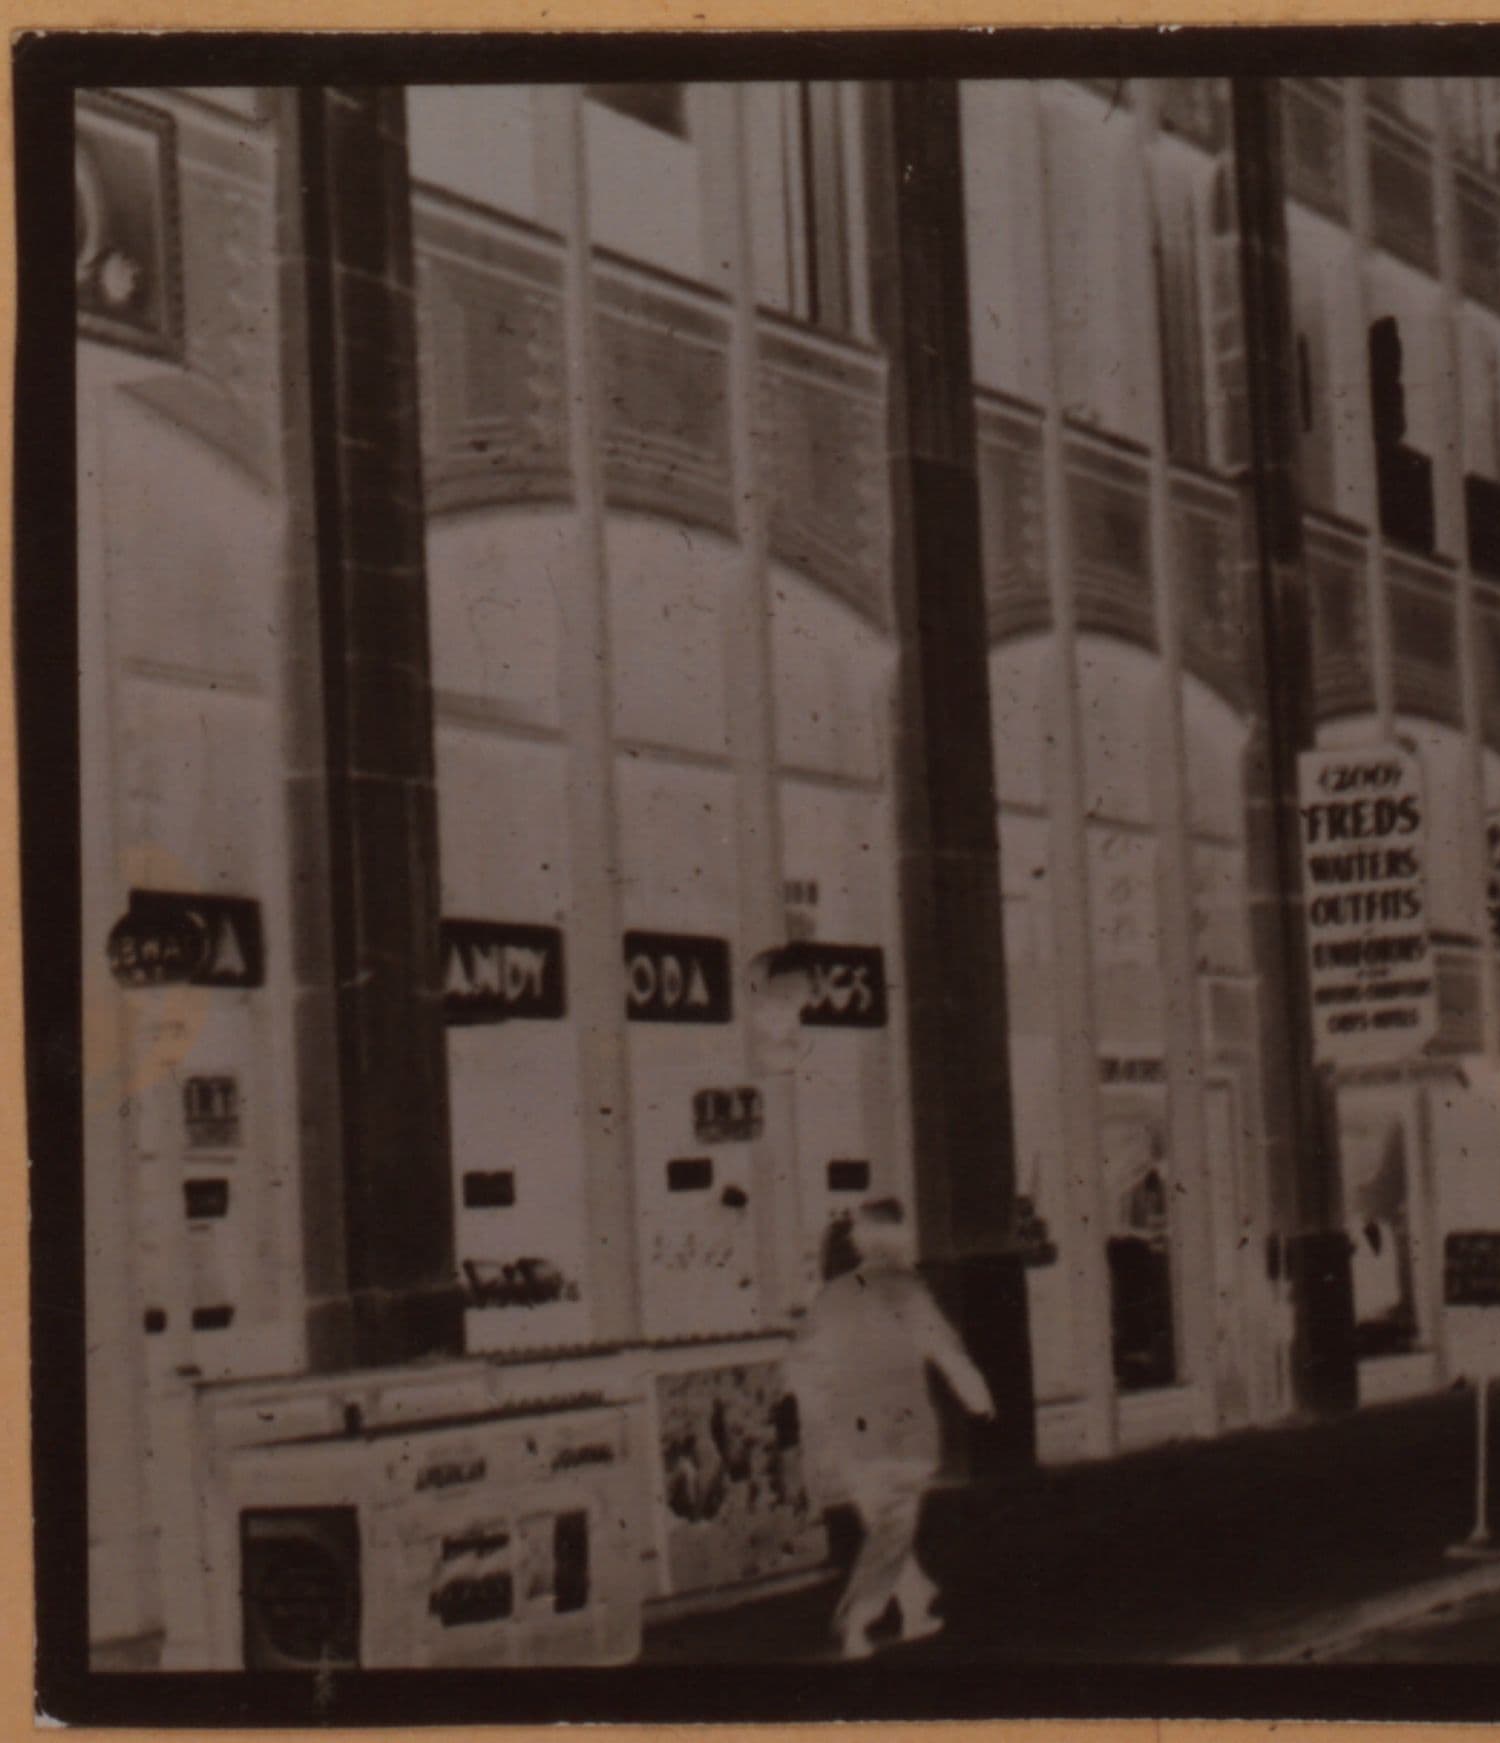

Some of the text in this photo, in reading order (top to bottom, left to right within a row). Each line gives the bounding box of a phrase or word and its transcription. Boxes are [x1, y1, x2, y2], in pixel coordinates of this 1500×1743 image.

[1310, 887, 1422, 928] OUTFITS
[444, 942, 549, 1002] ANDY
[627, 951, 711, 1008] ODA
[809, 962, 874, 1014] UGS
